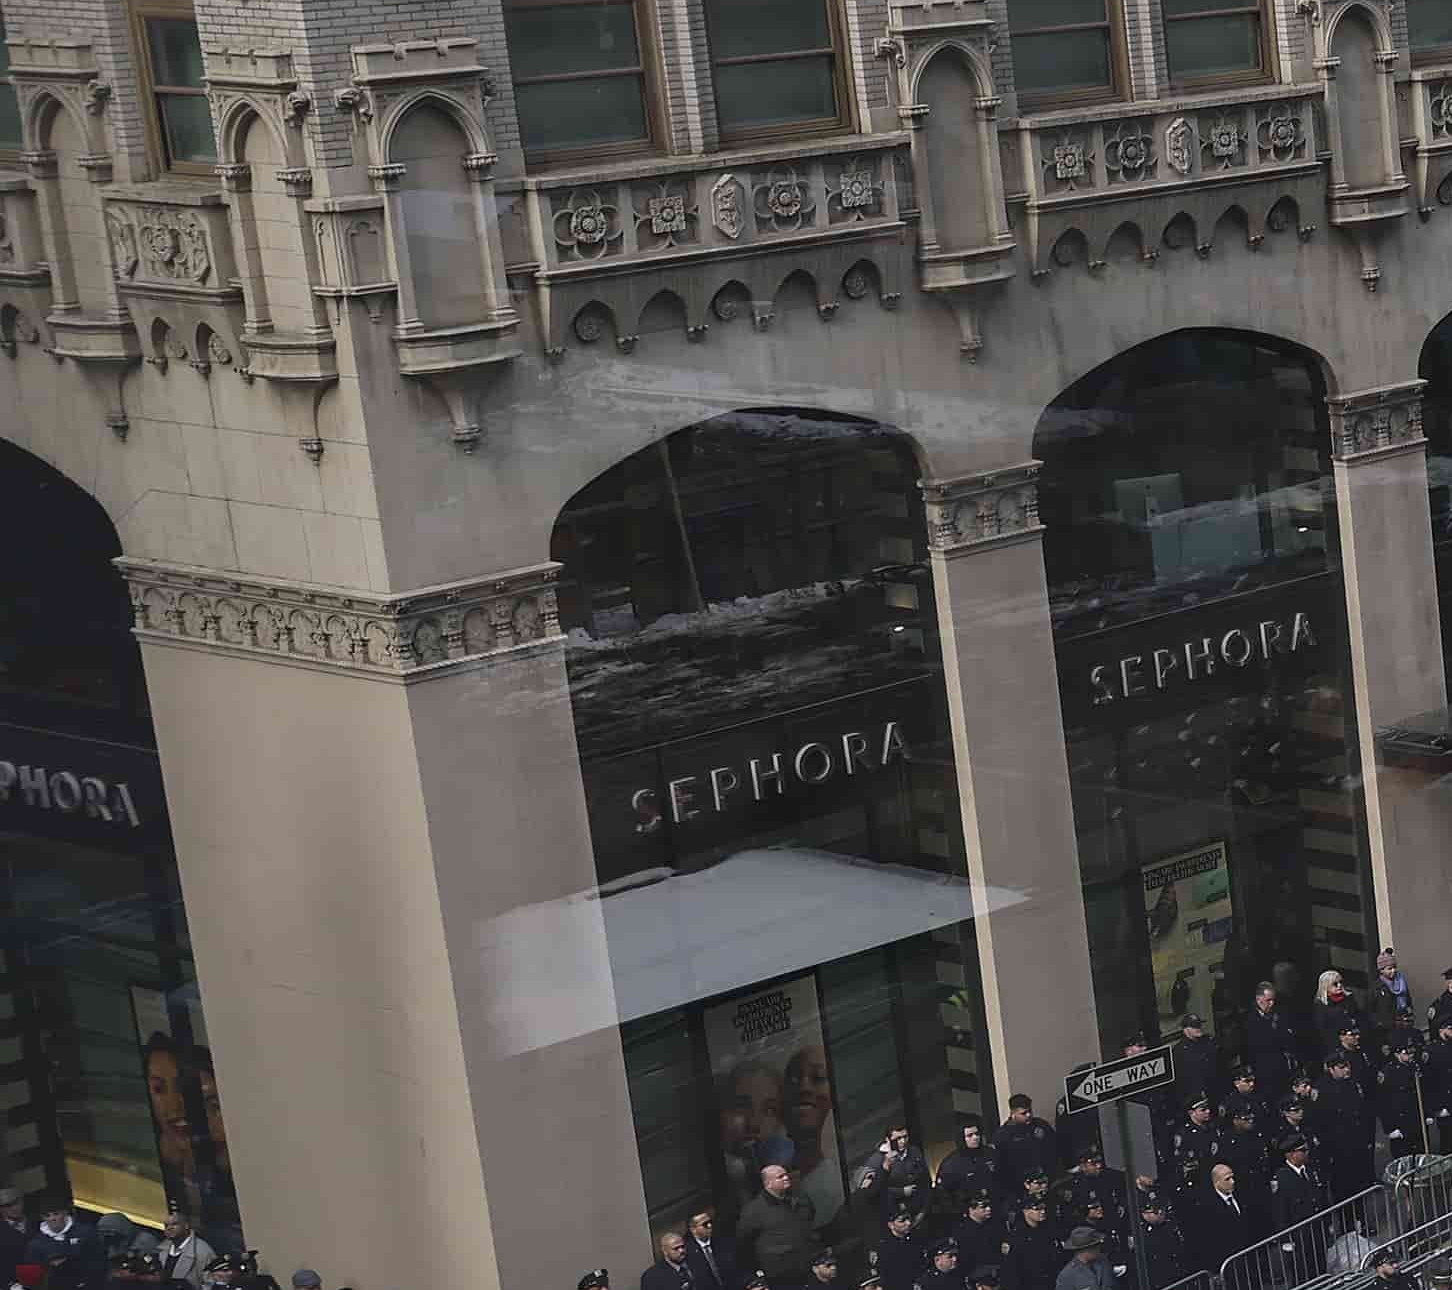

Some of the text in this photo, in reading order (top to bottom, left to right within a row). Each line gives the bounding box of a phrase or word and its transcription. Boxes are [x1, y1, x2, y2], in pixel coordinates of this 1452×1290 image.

[1091, 612, 1317, 705] SEPHORA
[632, 721, 912, 832] SEPHORA
[1083, 1060, 1158, 1095] ONE WAY
